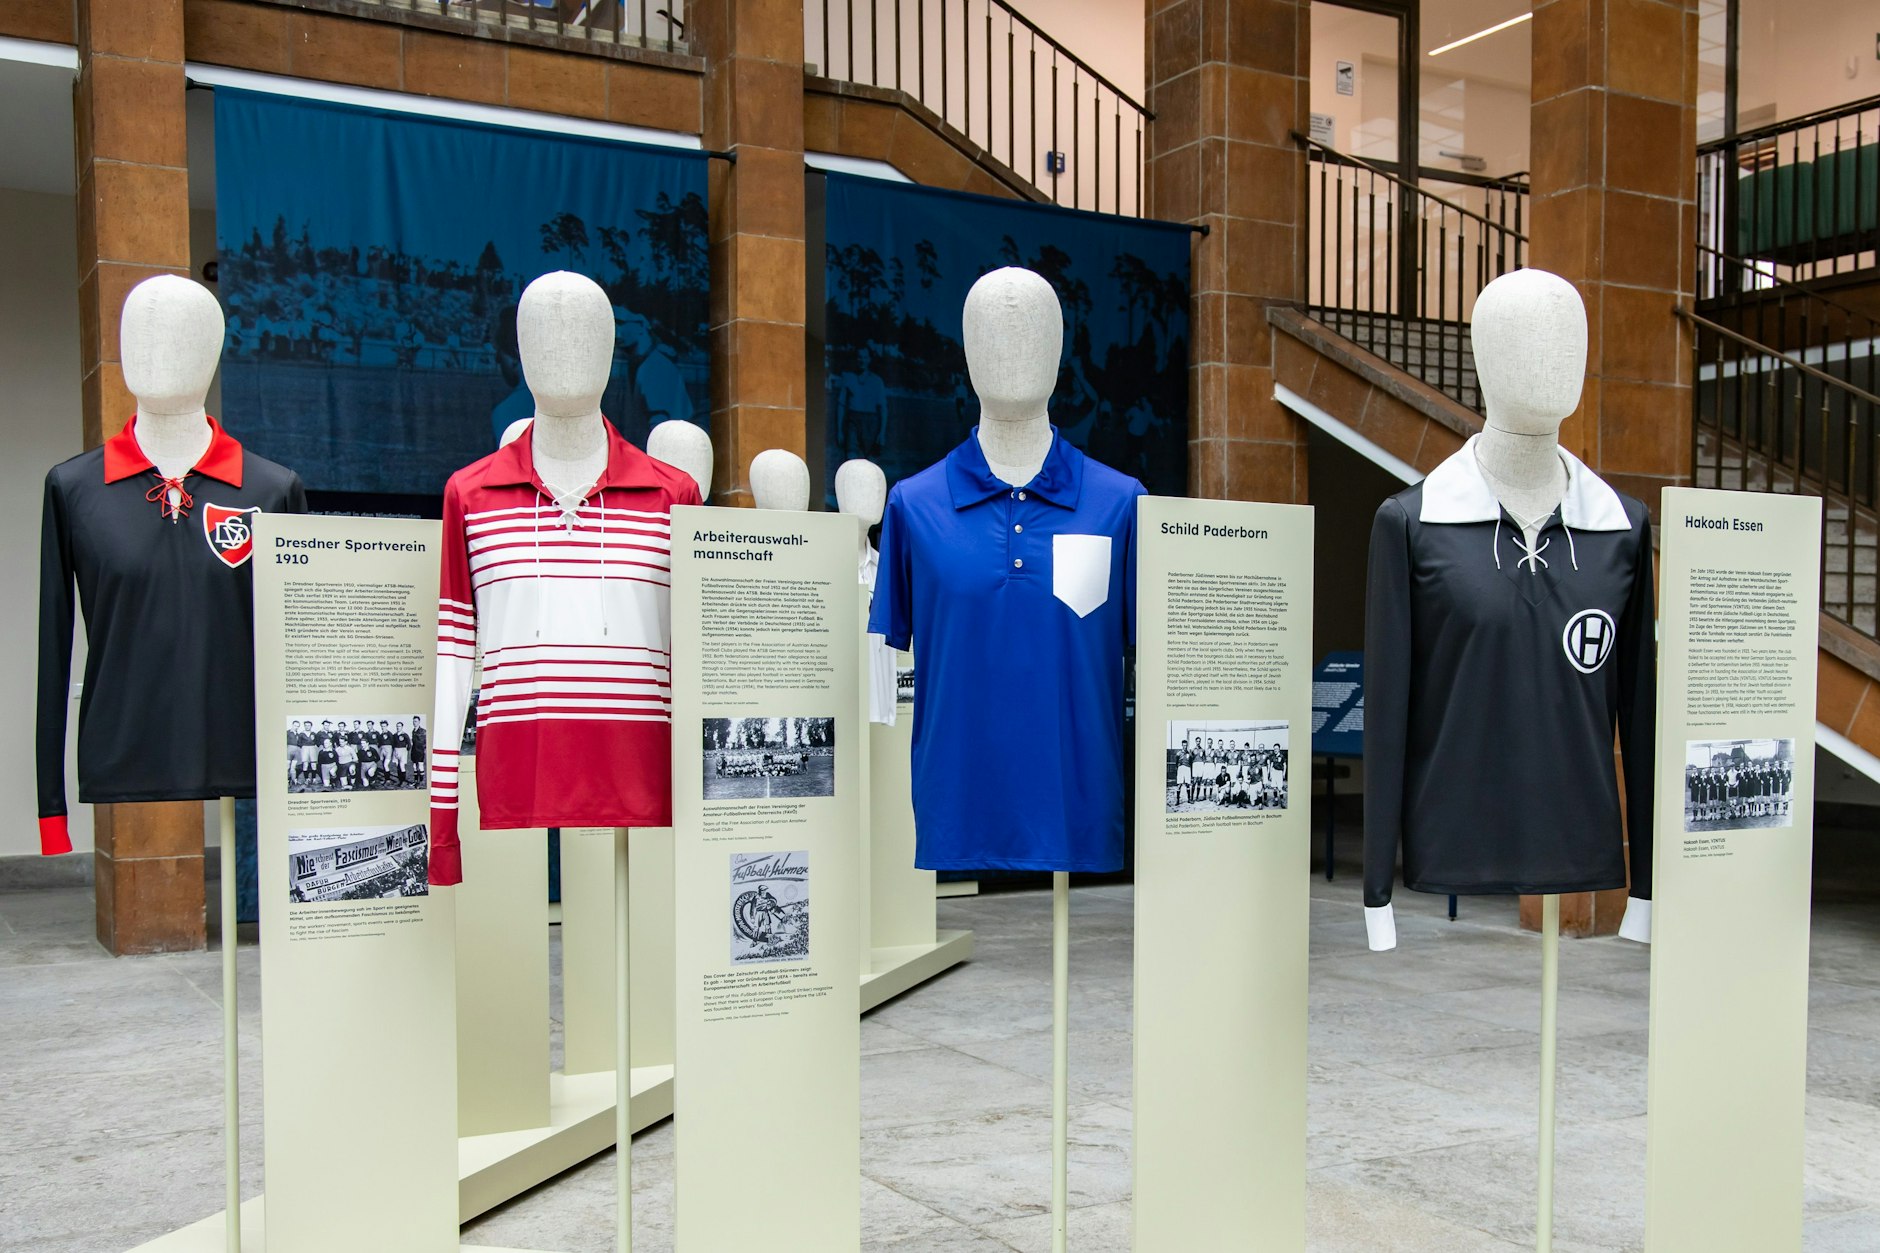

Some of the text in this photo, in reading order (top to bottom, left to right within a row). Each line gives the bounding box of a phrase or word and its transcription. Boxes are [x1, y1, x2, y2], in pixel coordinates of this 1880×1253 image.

[1161, 522, 1268, 539] Schild Paderborn
[1685, 516, 1763, 532] Hakoah Essen
[276, 537, 426, 552] Dresdner Sportverein
[693, 530, 808, 546] Arbeiterauswahl-
[276, 554, 308, 564] 1910
[693, 550, 773, 561] mannschaft
[296, 854, 316, 874] Nie
[335, 844, 378, 865] Fascismus
[386, 836, 402, 850] Wien
